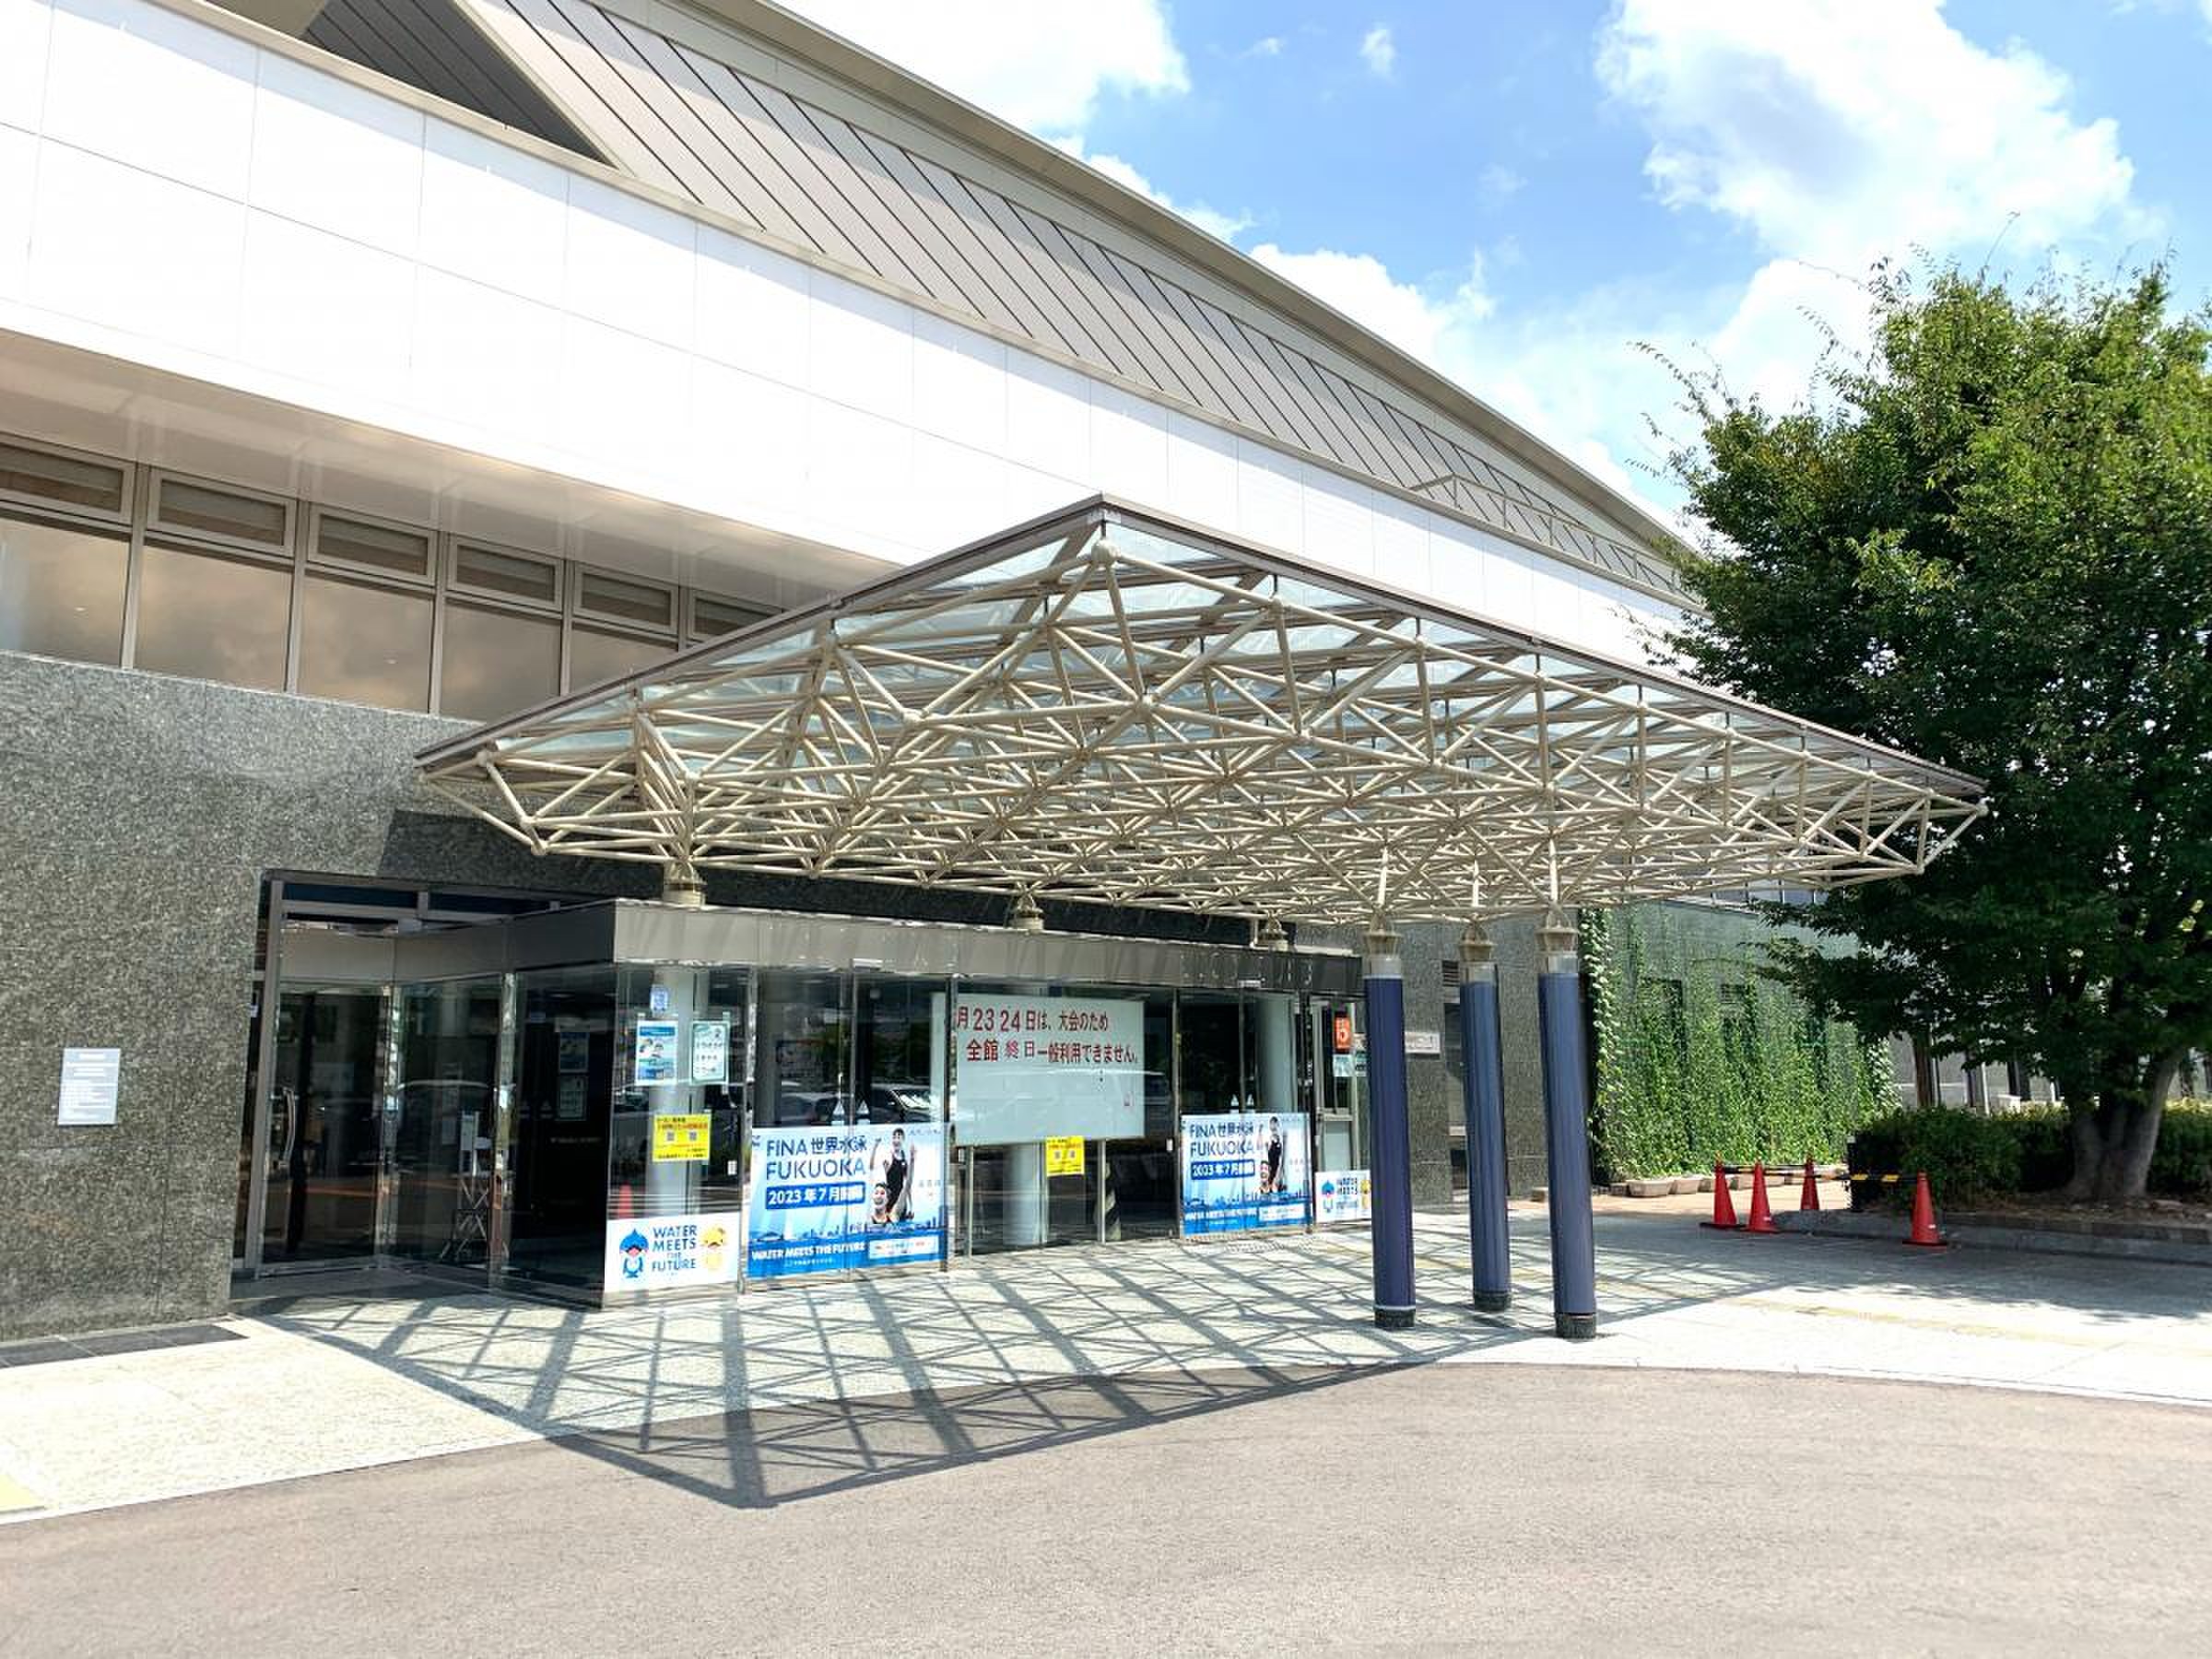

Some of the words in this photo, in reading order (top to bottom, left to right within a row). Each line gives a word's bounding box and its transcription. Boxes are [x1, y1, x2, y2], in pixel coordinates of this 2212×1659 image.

[766, 1139, 808, 1157] FINA
[766, 1158, 866, 1181] FUKUOKA
[653, 1225, 698, 1239] WATER
[653, 1238, 697, 1253] MEETS
[652, 1258, 697, 1272] FUTURE
